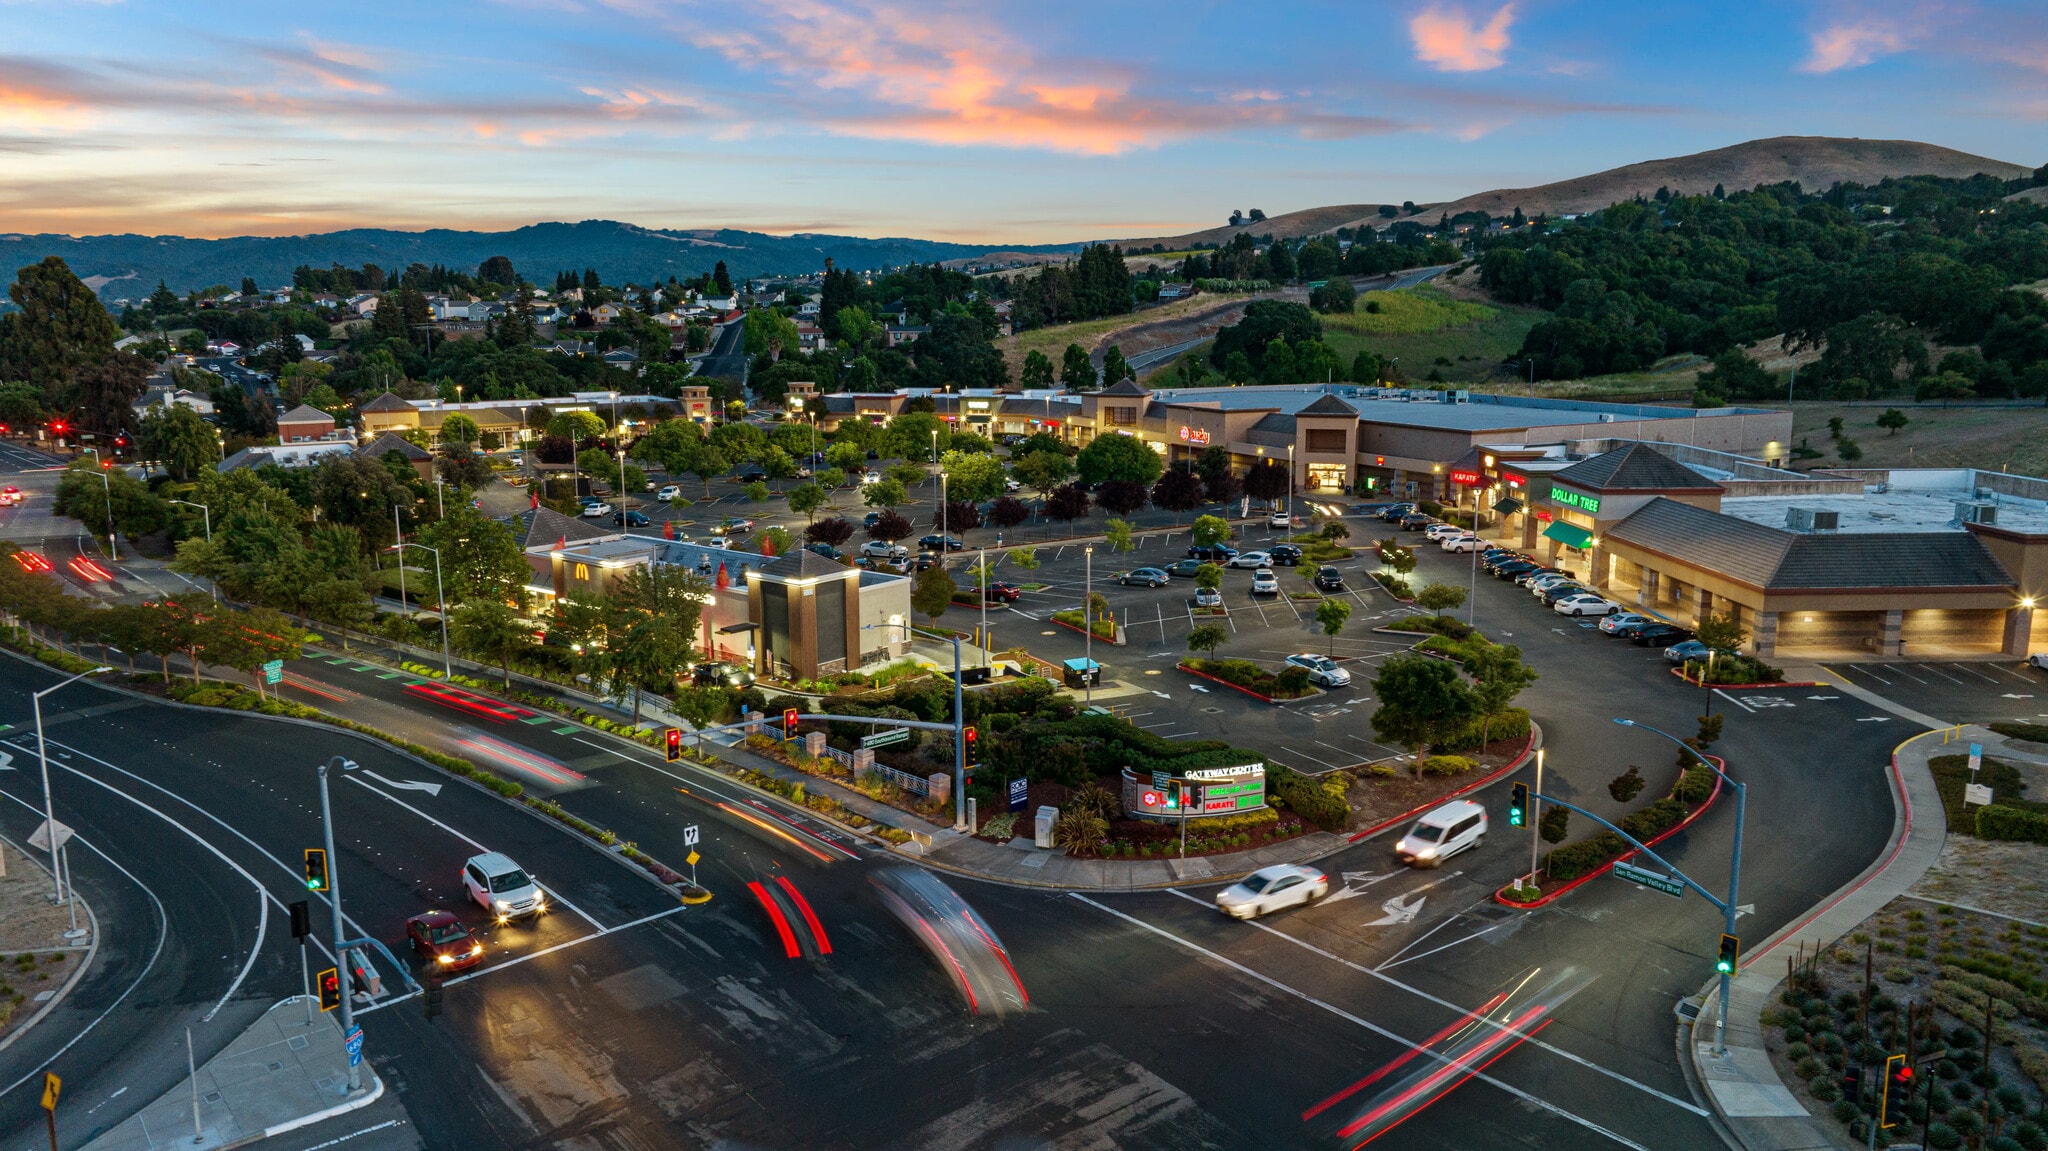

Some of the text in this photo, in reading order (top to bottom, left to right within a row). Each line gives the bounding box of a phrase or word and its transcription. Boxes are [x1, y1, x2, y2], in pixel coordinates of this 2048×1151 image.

[1454, 472, 1478, 483] KARATE
[1551, 487, 1599, 512] DOLLAR TREE
[1185, 763, 1265, 780] GATEWAY CENTRE
[1209, 786, 1240, 796] DOLLAR
[1206, 801, 1234, 810] KARATE
[1615, 867, 1681, 895] San Ramon Valley Blvd
[350, 1039, 361, 1052] 680
